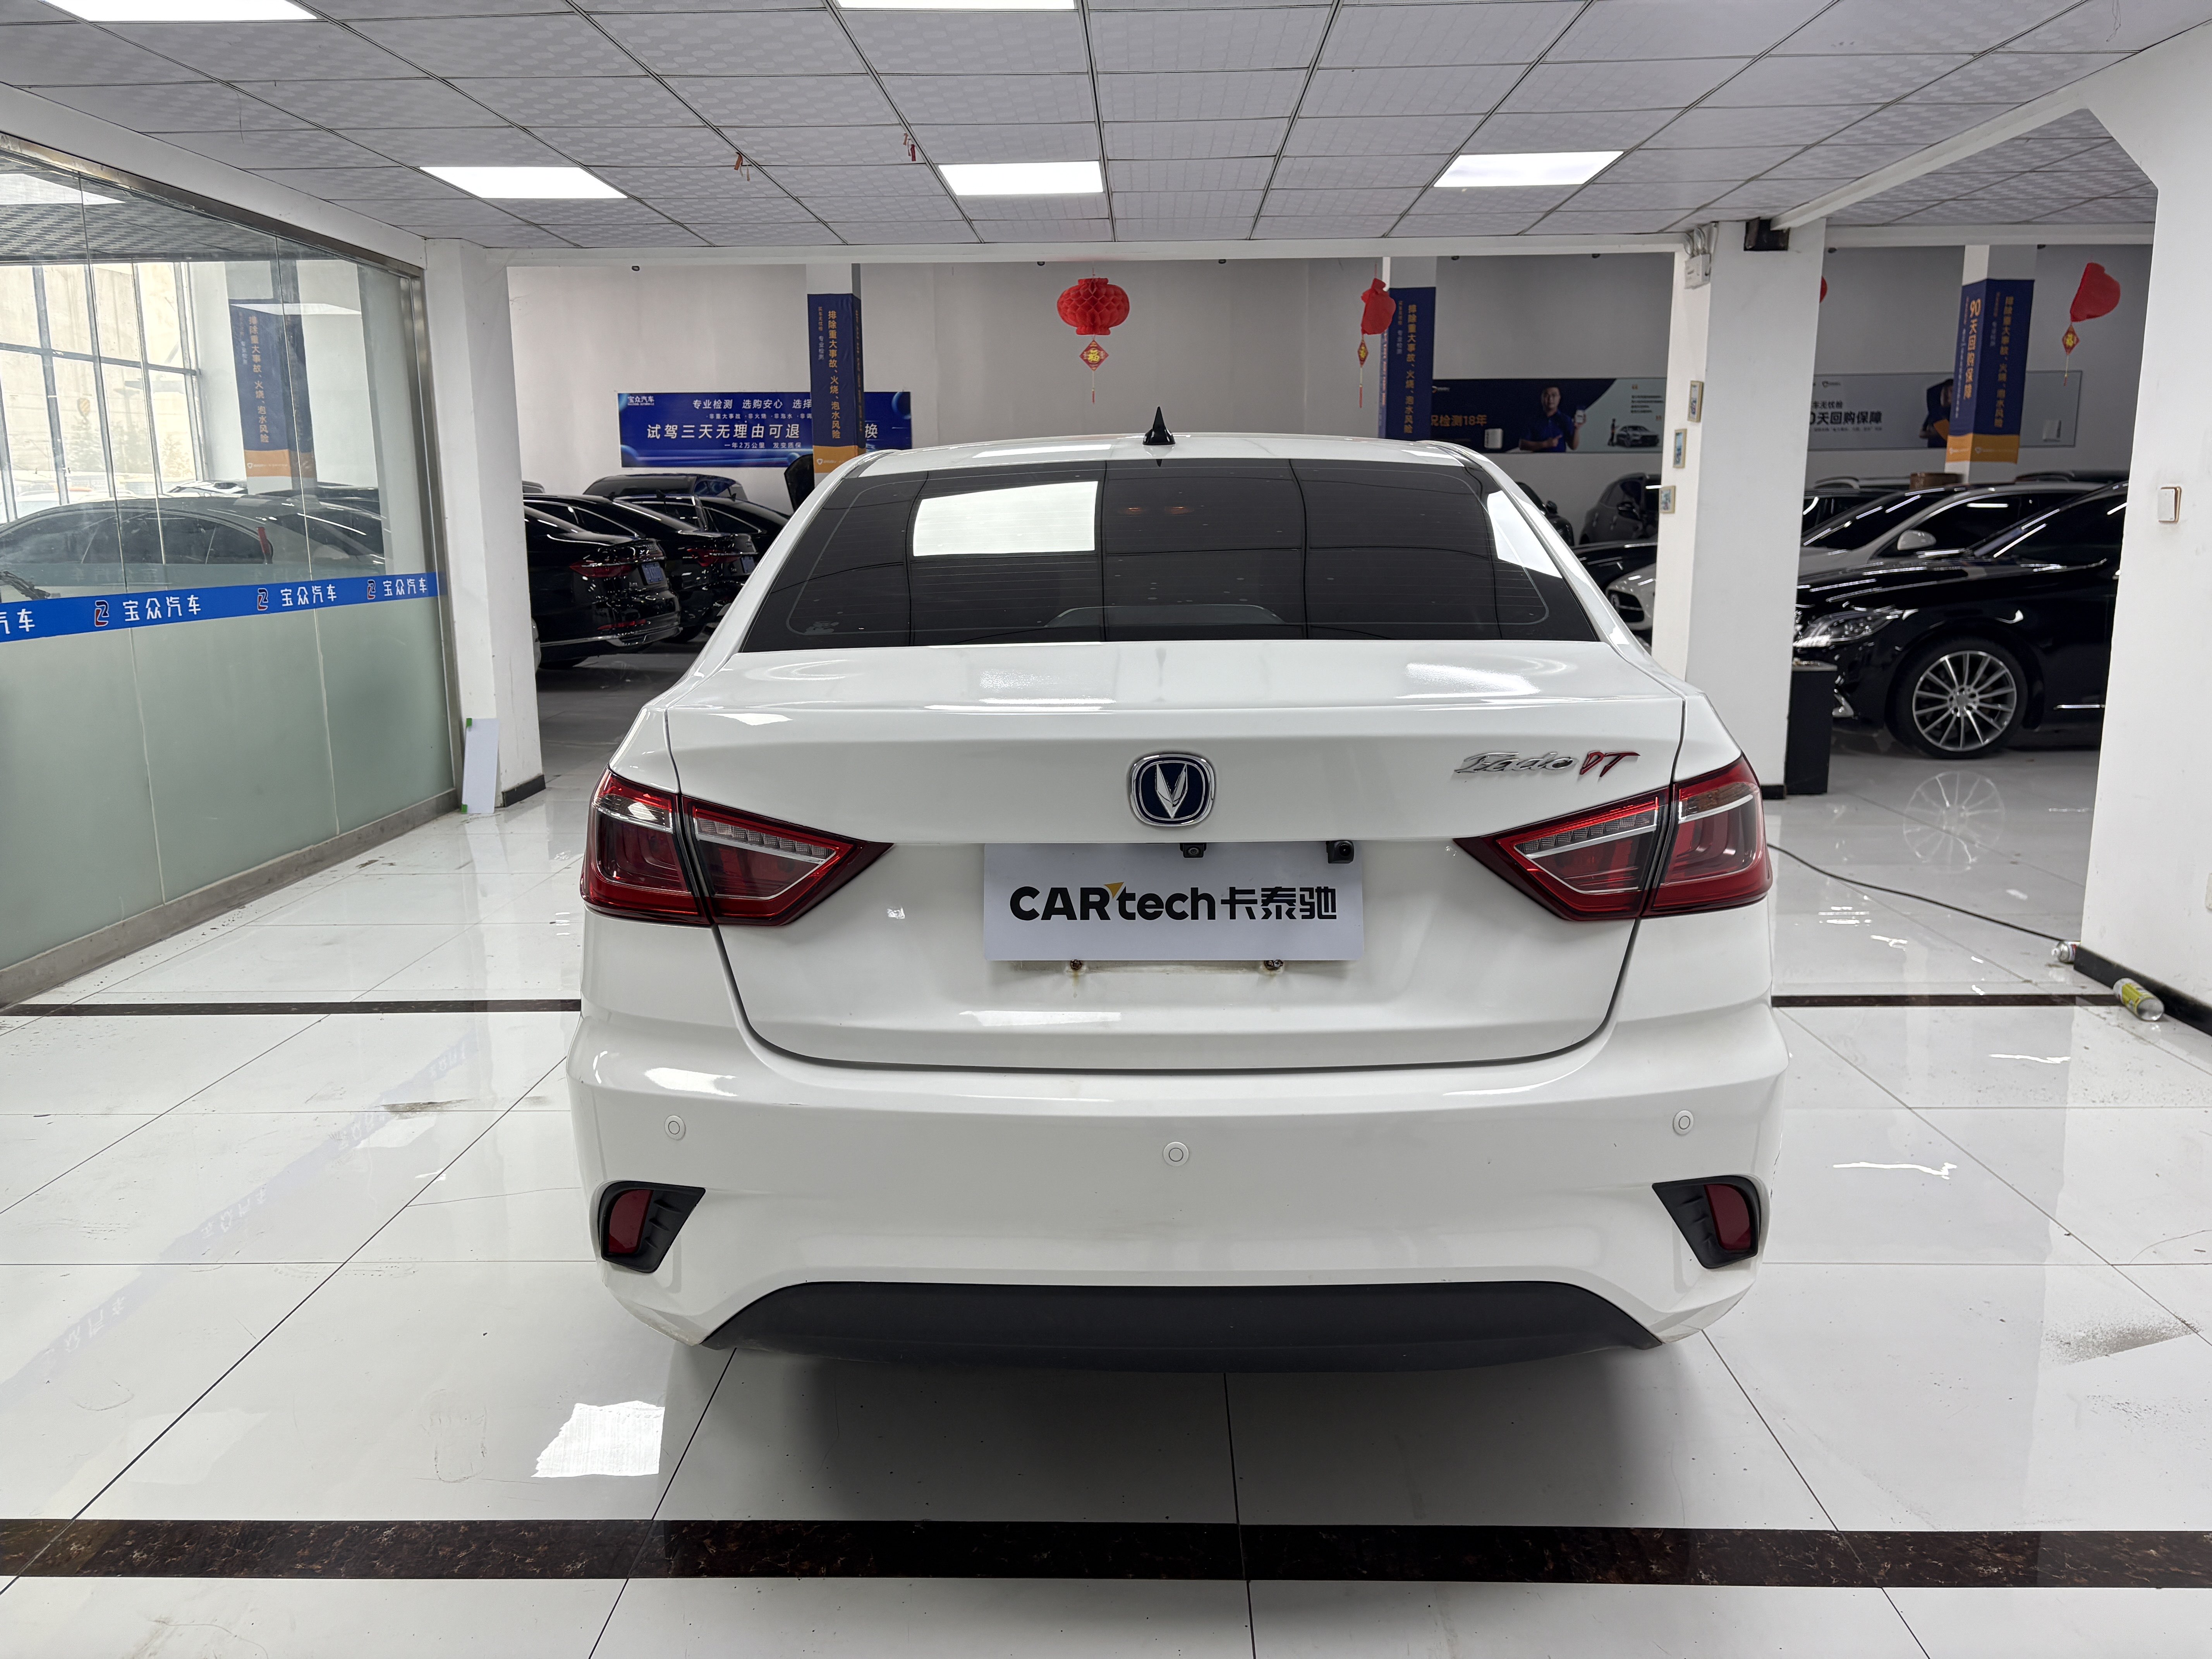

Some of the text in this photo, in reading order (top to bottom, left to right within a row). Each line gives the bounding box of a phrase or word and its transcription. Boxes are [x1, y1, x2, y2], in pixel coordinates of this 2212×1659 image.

[828, 311, 841, 439] 排除重大事故、火烧、泡水风险
[693, 399, 733, 409] 专业检测
[742, 399, 783, 409] 选购安心
[647, 424, 878, 439] 试驾三天无理由可退 换
[281, 584, 337, 607] 宝众汽车
[383, 577, 428, 597] 宝众汽车
[123, 594, 201, 622] 宝众汽车
[1010, 886, 1337, 921] CARtech 卡泰驰
